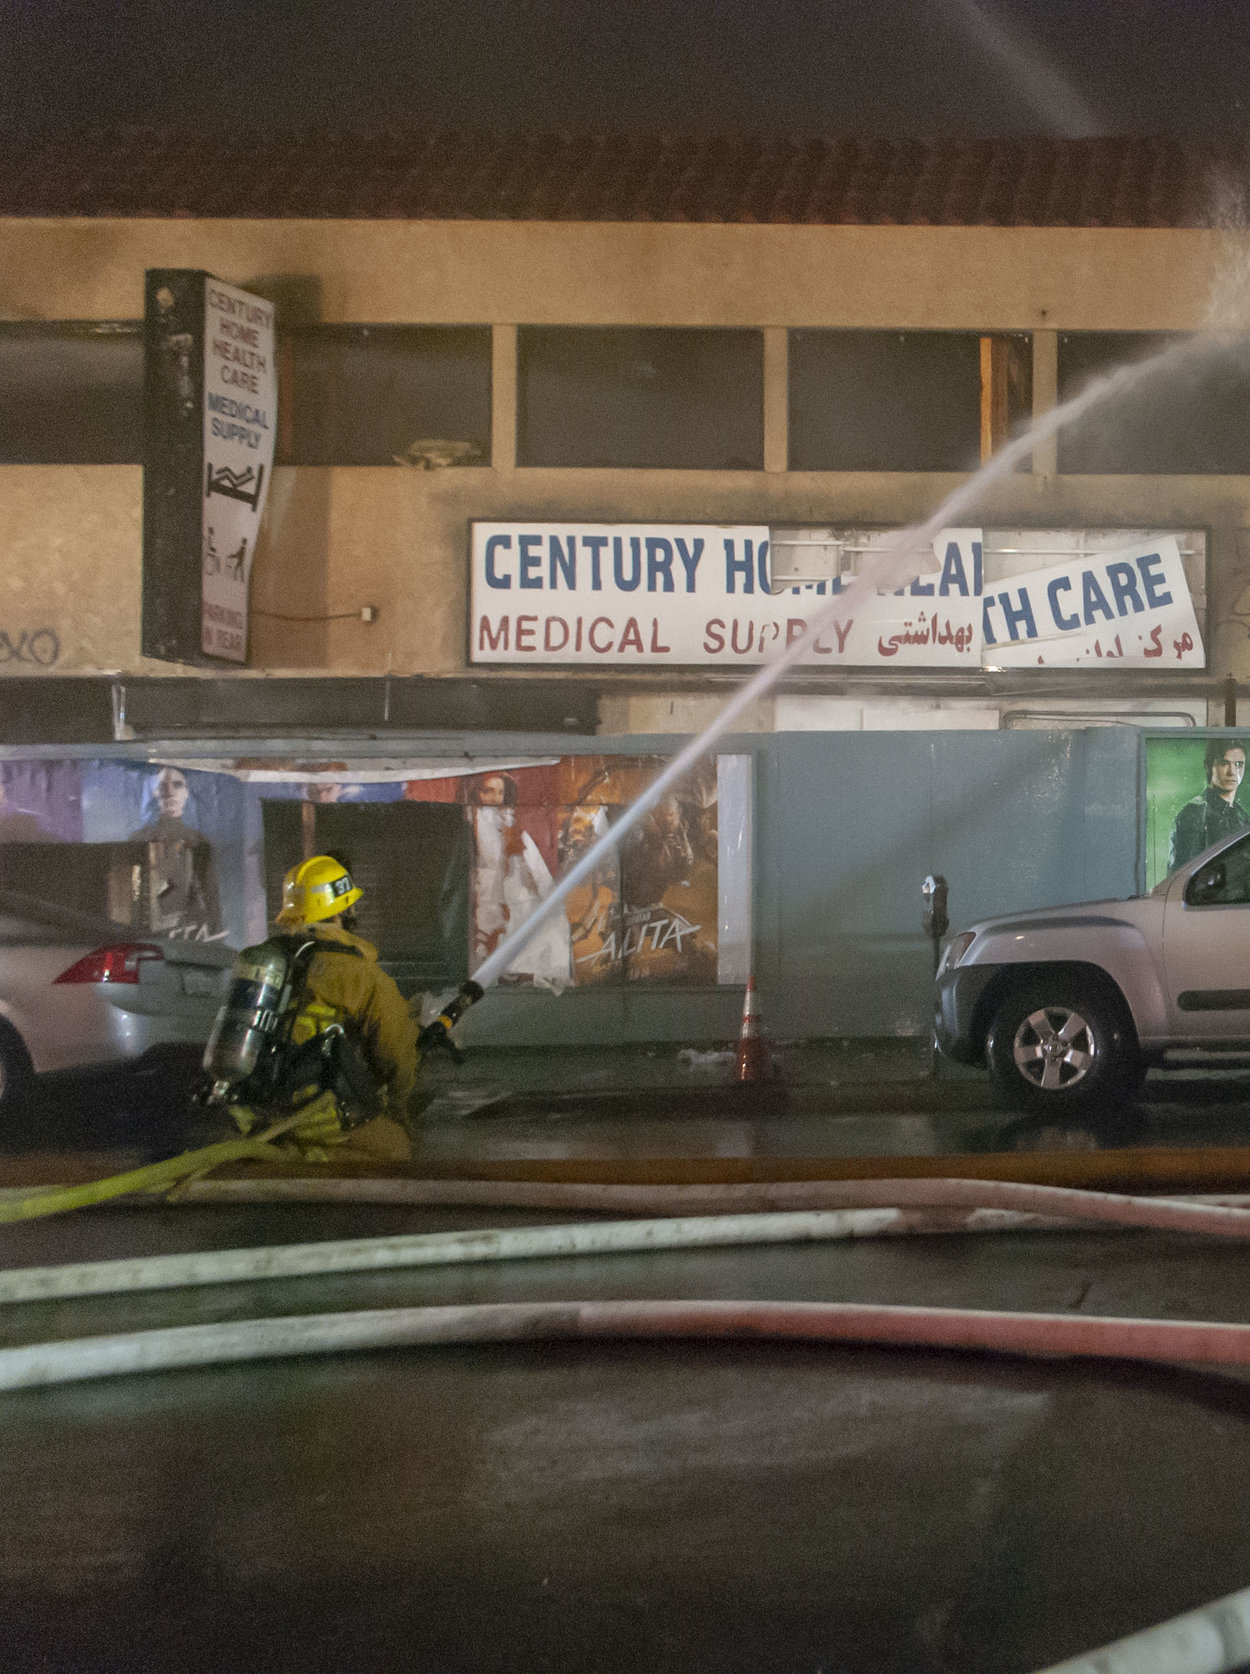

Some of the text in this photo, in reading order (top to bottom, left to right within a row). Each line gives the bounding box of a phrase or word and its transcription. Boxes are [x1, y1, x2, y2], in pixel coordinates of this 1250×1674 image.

[208, 288, 272, 329] CENTURY
[219, 316, 259, 349] HOME
[213, 337, 267, 375] HEALTH
[220, 365, 259, 394] CARE
[208, 391, 269, 430] MEDICAL
[212, 416, 261, 449] SUPPLY
[484, 534, 704, 593] CENTURY
[1047, 553, 1173, 631] CARE
[478, 615, 671, 654] MEDICAL
[335, 877, 350, 895] 37
[577, 918, 702, 966] ALITA
